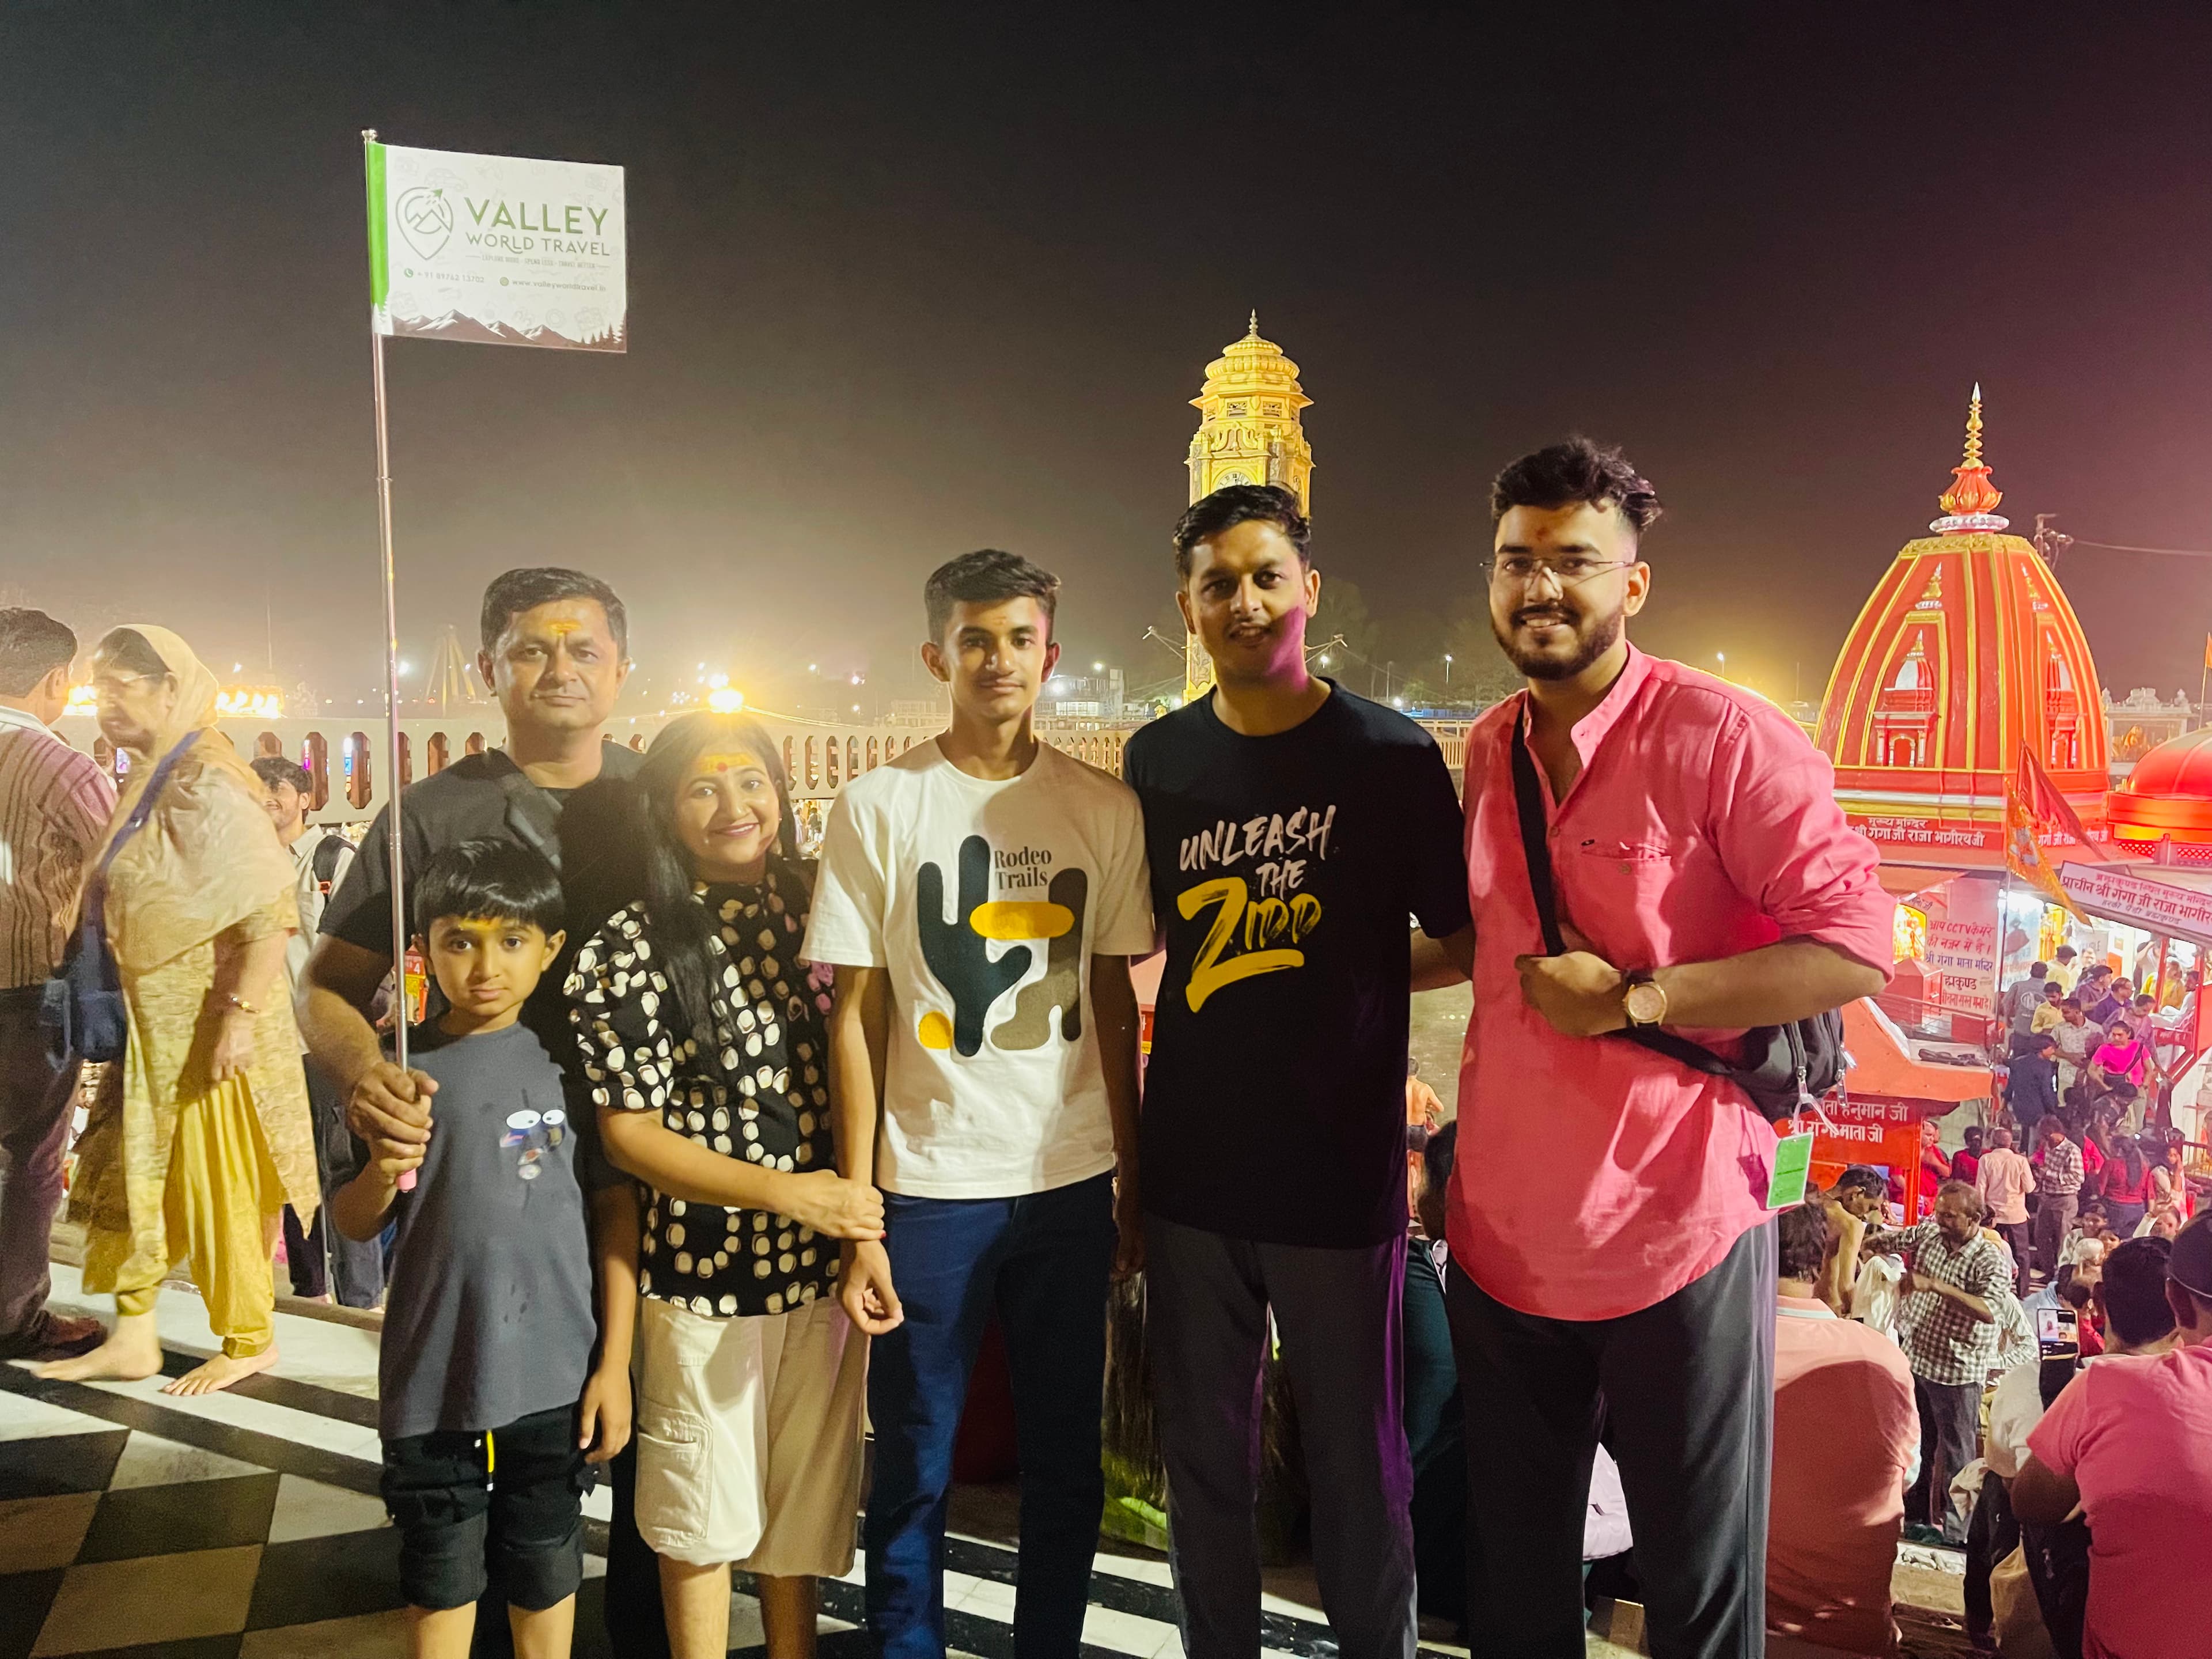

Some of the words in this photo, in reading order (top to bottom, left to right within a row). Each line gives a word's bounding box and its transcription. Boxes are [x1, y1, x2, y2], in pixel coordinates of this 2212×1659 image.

[464, 197, 608, 236] VALLEY
[465, 232, 533, 254] WORLD
[541, 238, 610, 256] TRAVEL
[1180, 805, 1336, 871] UNLEASH
[1908, 829, 1933, 843] राजा
[1971, 831, 1985, 847] जी
[994, 846, 1052, 869] Rodeo
[995, 866, 1048, 890] Trails
[1256, 859, 1307, 900] THE
[2062, 876, 2094, 893] प्राचीन
[2096, 883, 2111, 899] श्री
[2138, 893, 2152, 908] जी
[2153, 899, 2178, 914] राजा
[2179, 903, 2212, 925] भागीर
[1947, 922, 1972, 935] CCTV
[1943, 975, 1978, 990] ह्मकुण्ड
[1889, 1101, 1909, 1122] जी
[1839, 1125, 1866, 1142] माता
[1867, 1123, 1884, 1143] जी
